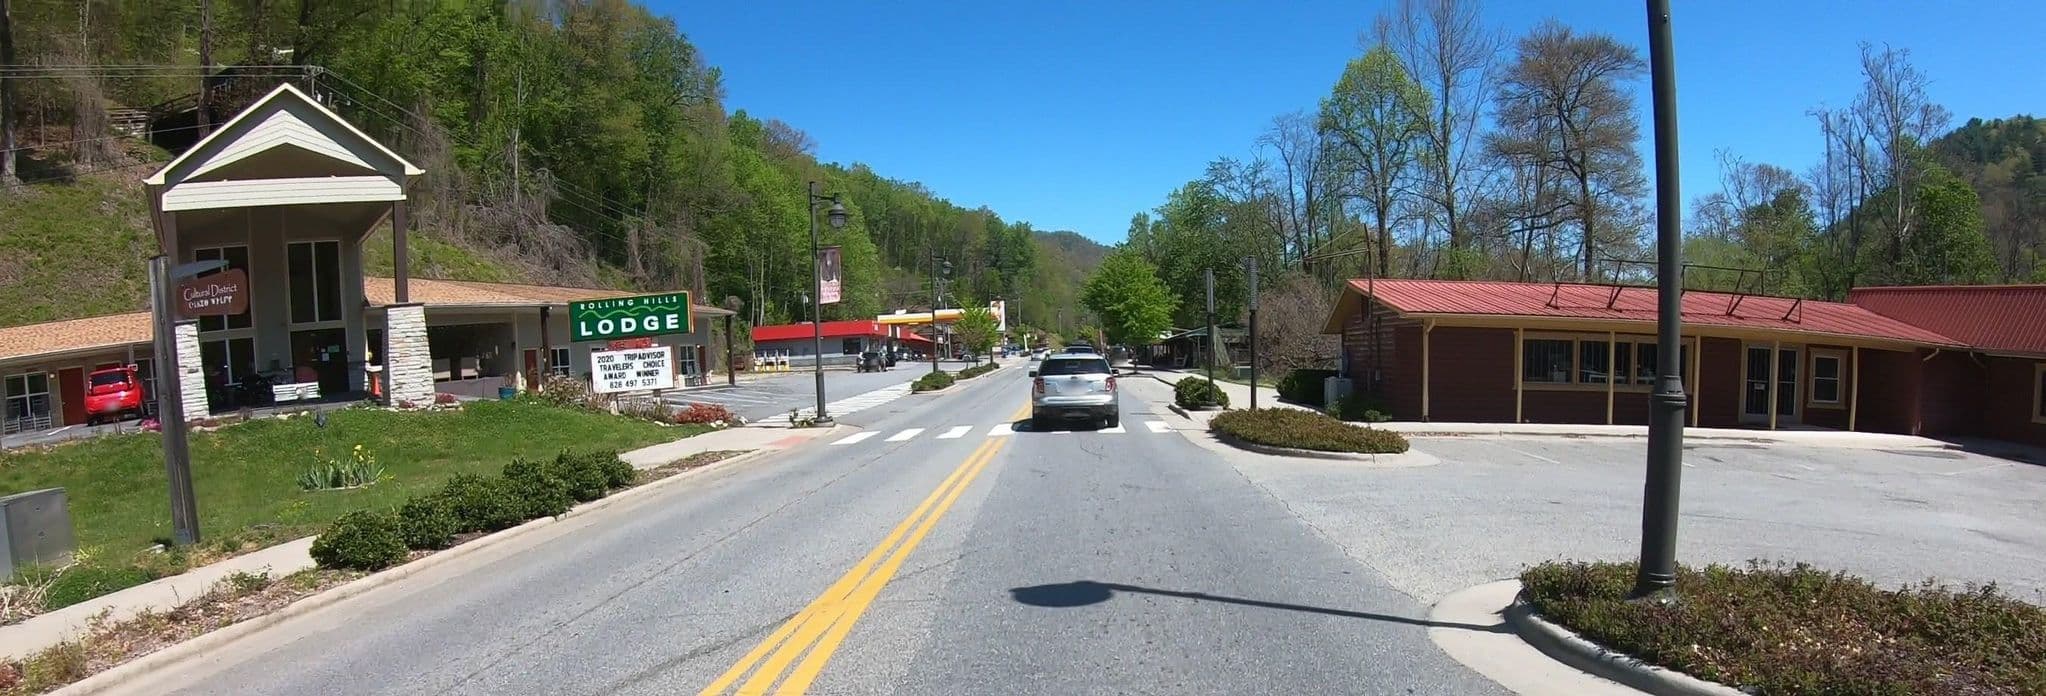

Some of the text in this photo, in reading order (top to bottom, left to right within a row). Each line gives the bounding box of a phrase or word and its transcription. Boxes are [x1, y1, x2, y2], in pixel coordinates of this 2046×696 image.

[184, 284, 237, 301] Cultural District
[580, 296, 677, 310] ROLLING HILLS
[580, 314, 679, 337] LODGE
[597, 354, 614, 364] 2020
[600, 360, 665, 372] TRAVELERS CHOICE
[604, 369, 659, 380] AWARD WINNER
[609, 378, 657, 389] 828 497 5371
